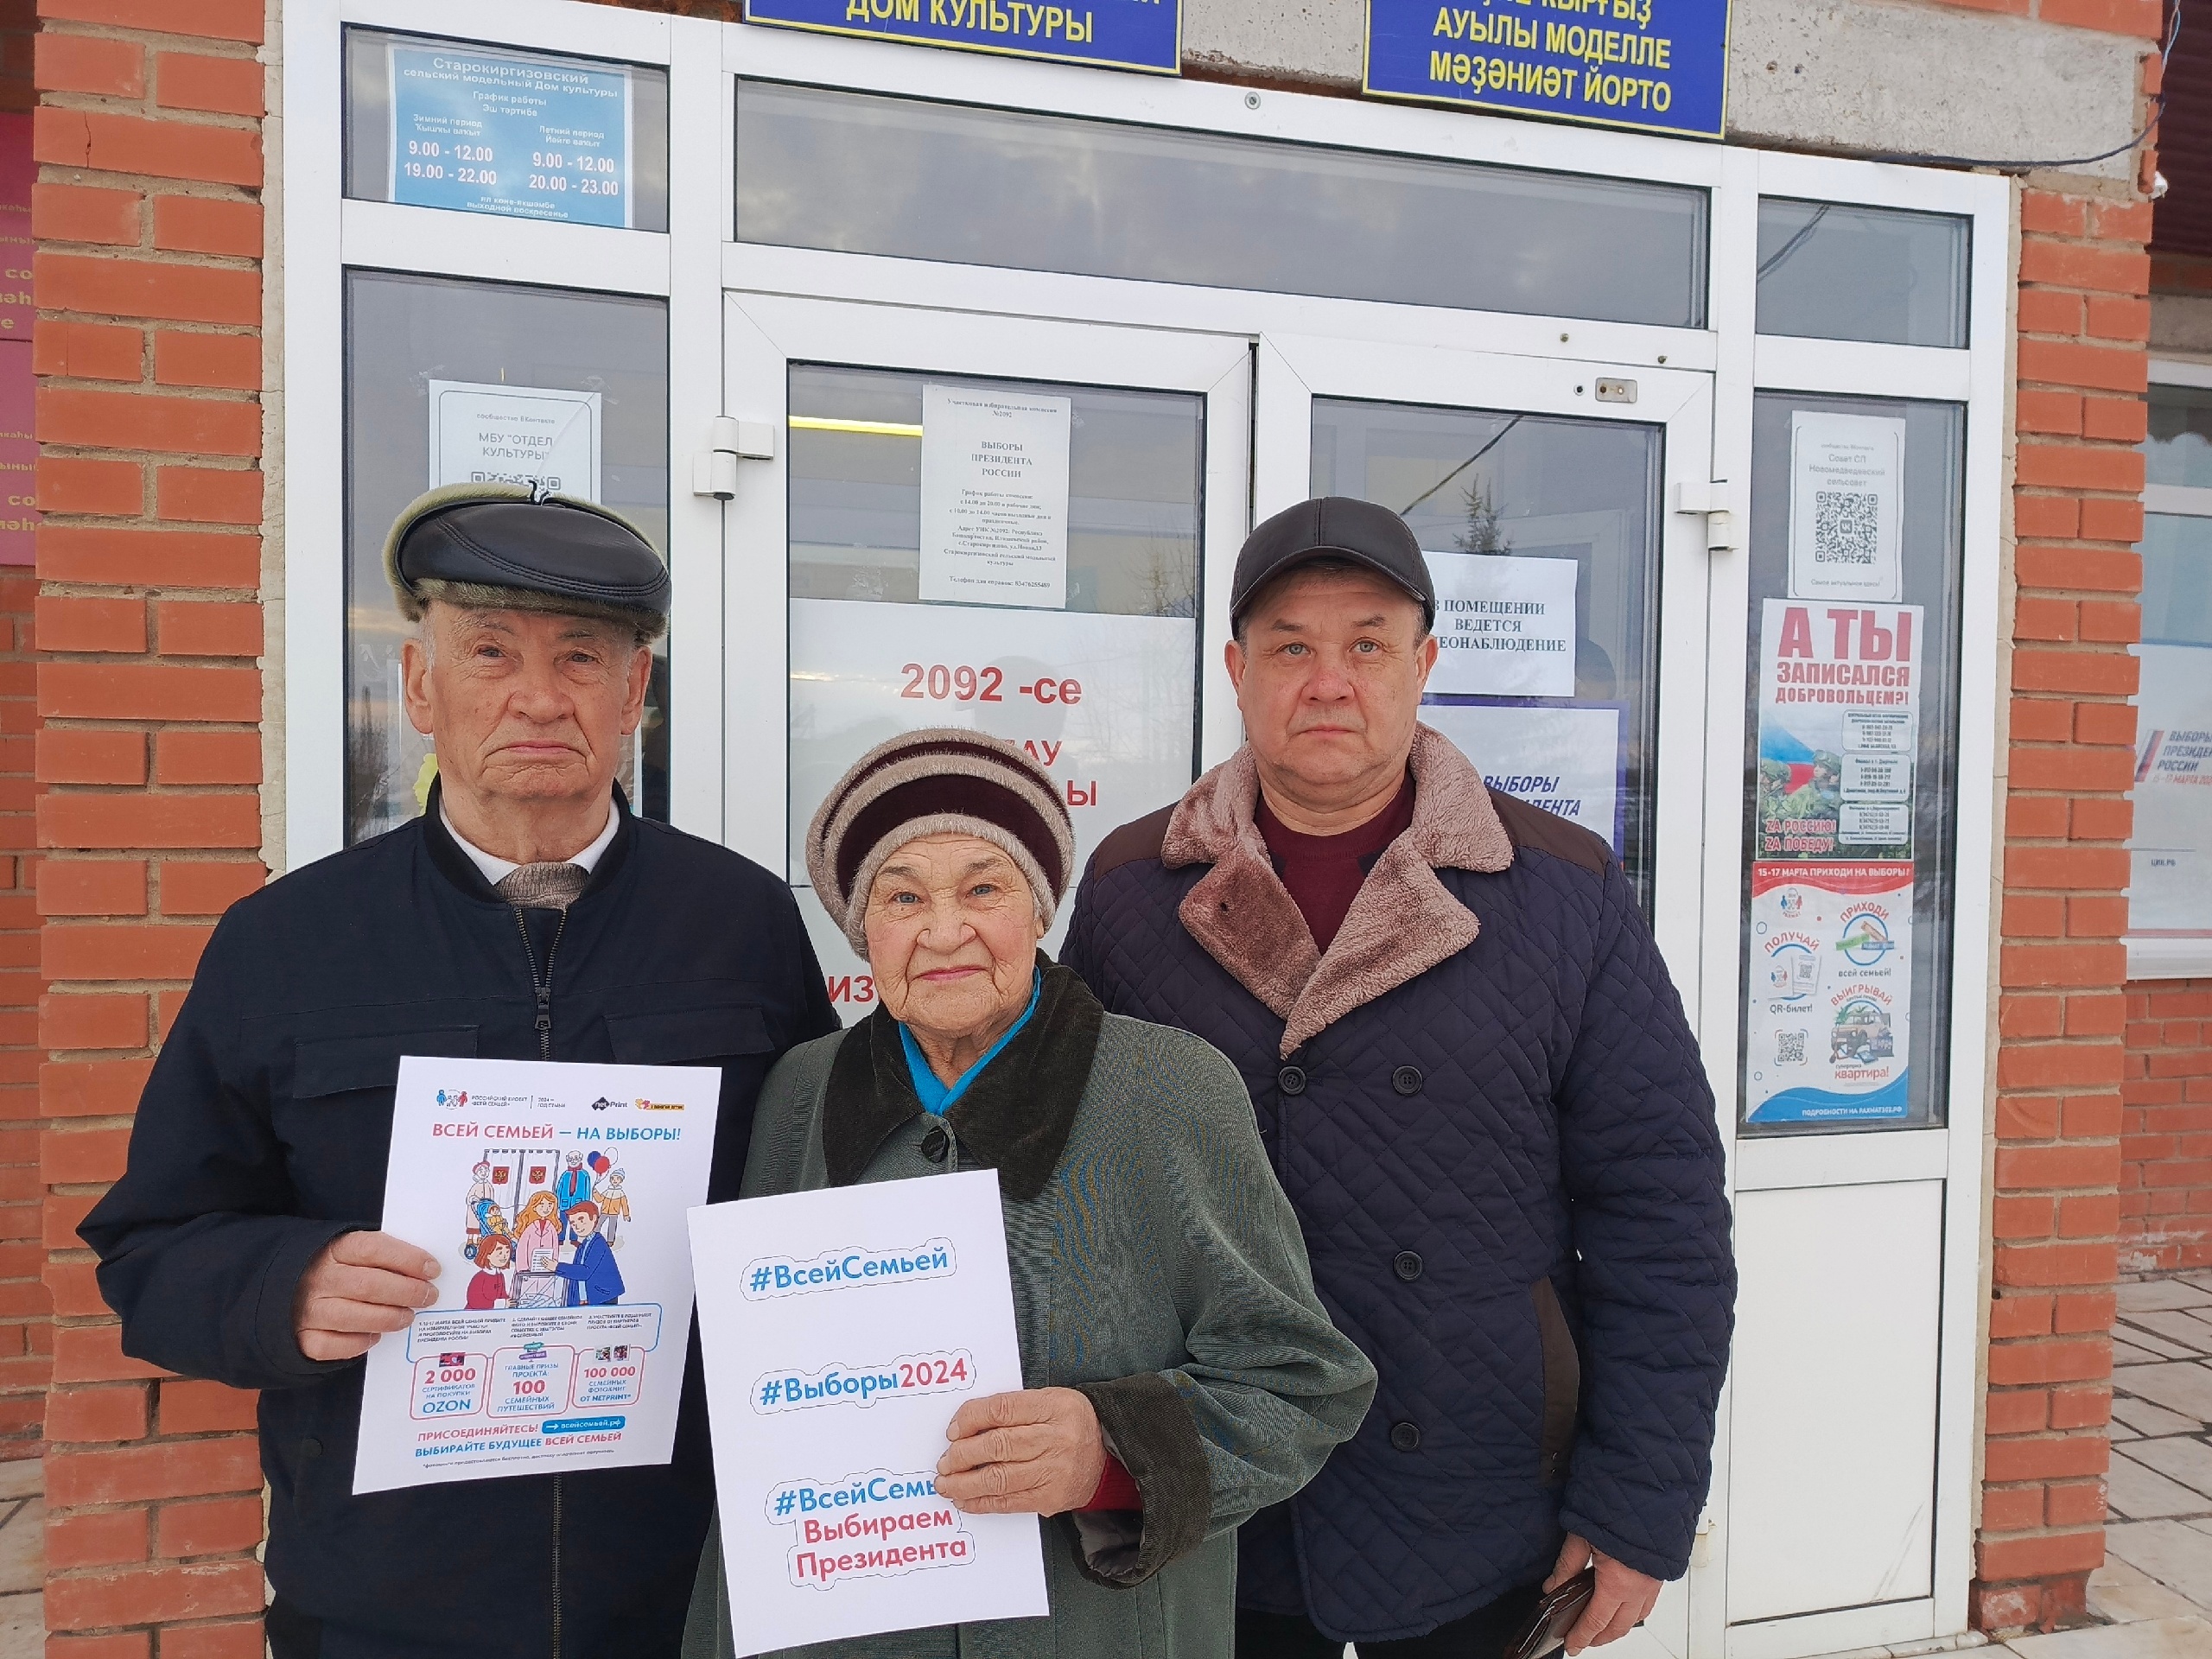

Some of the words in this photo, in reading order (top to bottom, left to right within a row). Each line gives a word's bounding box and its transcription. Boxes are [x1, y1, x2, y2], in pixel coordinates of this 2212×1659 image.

[931, 0, 1092, 43] КУЛЬТУРЫ
[1433, 6, 1538, 50] АУЫЛЫ
[1545, 22, 1671, 69] МОДЕЛЛЕ
[433, 57, 588, 85] Старокиргизовский
[404, 69, 459, 80] сельский
[463, 75, 532, 87] модельный
[535, 80, 559, 92] Дом
[563, 86, 618, 98] культуры
[1429, 50, 1579, 99] МӘҘӘНИӘТ
[1584, 65, 1672, 112] ЙОРТО
[473, 91, 509, 102] График
[512, 96, 547, 105] работы
[483, 104, 498, 113] Эш
[413, 113, 448, 124] Зимний
[450, 119, 482, 129] период
[539, 125, 570, 135] Летний
[572, 130, 605, 139] период
[409, 140, 440, 157] 9.00
[454, 144, 493, 162] 12.00
[532, 151, 563, 168] 9.00
[576, 156, 614, 173] 12.00
[404, 162, 444, 179] 19.00
[457, 167, 497, 185] 22.00
[529, 174, 567, 192] 20.00
[581, 178, 619, 196] 23.00
[467, 201, 512, 213] выходной
[514, 207, 569, 219] воскресенье
[479, 432, 504, 443] МБУ
[981, 441, 1023, 452] ВЫБОРЫ
[971, 454, 1033, 466] ПРЕЗИДЕНТА
[1853, 454, 1866, 463] СП
[982, 467, 1021, 478] РОССИИ
[1444, 600, 1545, 616] ПОМЕЩЕНИИ
[1454, 618, 1522, 633] ВЕДЕТСЯ
[1777, 607, 1814, 658] А
[1827, 608, 1912, 662] ТЫ
[899, 662, 1004, 702] 2092
[1018, 677, 1083, 705] -се
[1777, 661, 1910, 688] ЗАПИСАЛСЯ
[1775, 687, 1909, 707] ДОБРОВОЛЬЦЕМ?!
[2157, 760, 2199, 772] РОССИИ
[1484, 775, 1560, 793] ВЫБОРЫ
[1784, 819, 1836, 835] РОССИЮ!
[1784, 836, 1834, 854] ПОБЕДУ!
[1758, 868, 1781, 877] 15-17
[1782, 868, 1808, 877] МАРТА
[1809, 868, 1854, 878] ПРИХОДИ
[1855, 868, 1866, 876] НА
[1840, 901, 1890, 924] ПРИХОДИ
[1764, 931, 1821, 953] ПОЛУЧАЙ
[1838, 969, 1858, 977] всей
[1859, 968, 1891, 977] семьей!
[1830, 983, 1893, 1007] ВЫИГРЫВАЙ
[1770, 1003, 1813, 1015] QR-билет!
[1834, 1066, 1890, 1081] квартира!
[1802, 1108, 1848, 1117] ПОДРОБНОСТИ
[432, 1122, 479, 1137] ВСЕЙ
[484, 1122, 554, 1139] СЕМЬЕЙ
[576, 1127, 601, 1140] НА
[606, 1127, 682, 1141] ВЫБОРЫ!
[749, 1246, 949, 1293] #ВсейСемьей
[423, 1370, 435, 1384] 2
[440, 1368, 476, 1382] 000
[583, 1368, 607, 1378] 100
[610, 1366, 636, 1377] 000
[422, 1383, 476, 1393] СЕРТИФИКАТОВ
[512, 1380, 545, 1395] 100
[760, 1357, 968, 1406] #Выборы2024
[423, 1399, 472, 1414] OZON
[498, 1402, 556, 1413] ПУТЕШЕСТВИЙ
[505, 1395, 550, 1404] СЕМЕЙНЫХ
[417, 1423, 538, 1442] ПРИСОЕДИНЯЙТЕСЬ!
[415, 1442, 486, 1458] ВЫБИРАЙТЕ
[488, 1438, 543, 1451] БУДУЩЕЕ
[545, 1434, 575, 1446] ВСЕЙ
[576, 1432, 622, 1444] СЕМЬЕЙ
[804, 1509, 953, 1545] Выбираем
[796, 1535, 967, 1581] Президента
